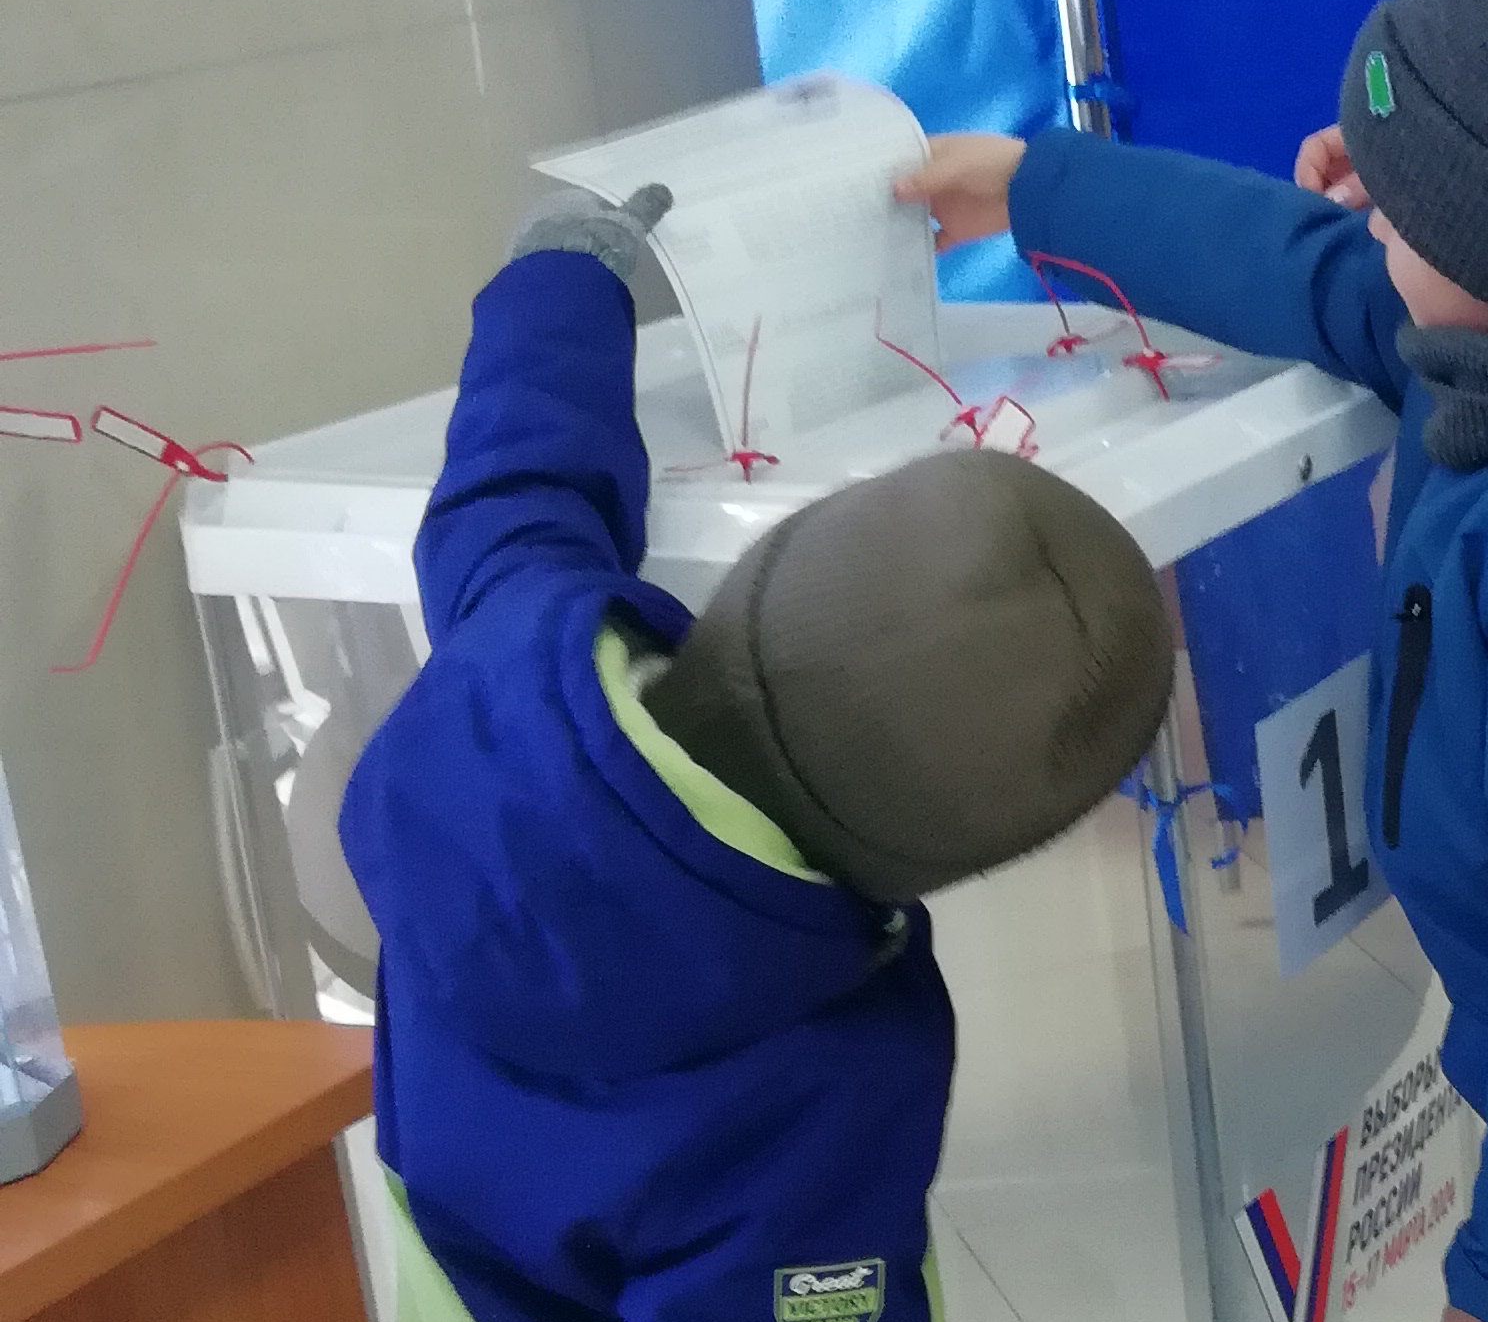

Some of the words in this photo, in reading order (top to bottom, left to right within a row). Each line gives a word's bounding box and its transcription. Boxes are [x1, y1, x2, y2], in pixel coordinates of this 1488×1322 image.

[1299, 709, 1369, 927] 1
[1360, 1045, 1441, 1149] ВЫБОРЫ
[1346, 1161, 1422, 1264] РОССИИ
